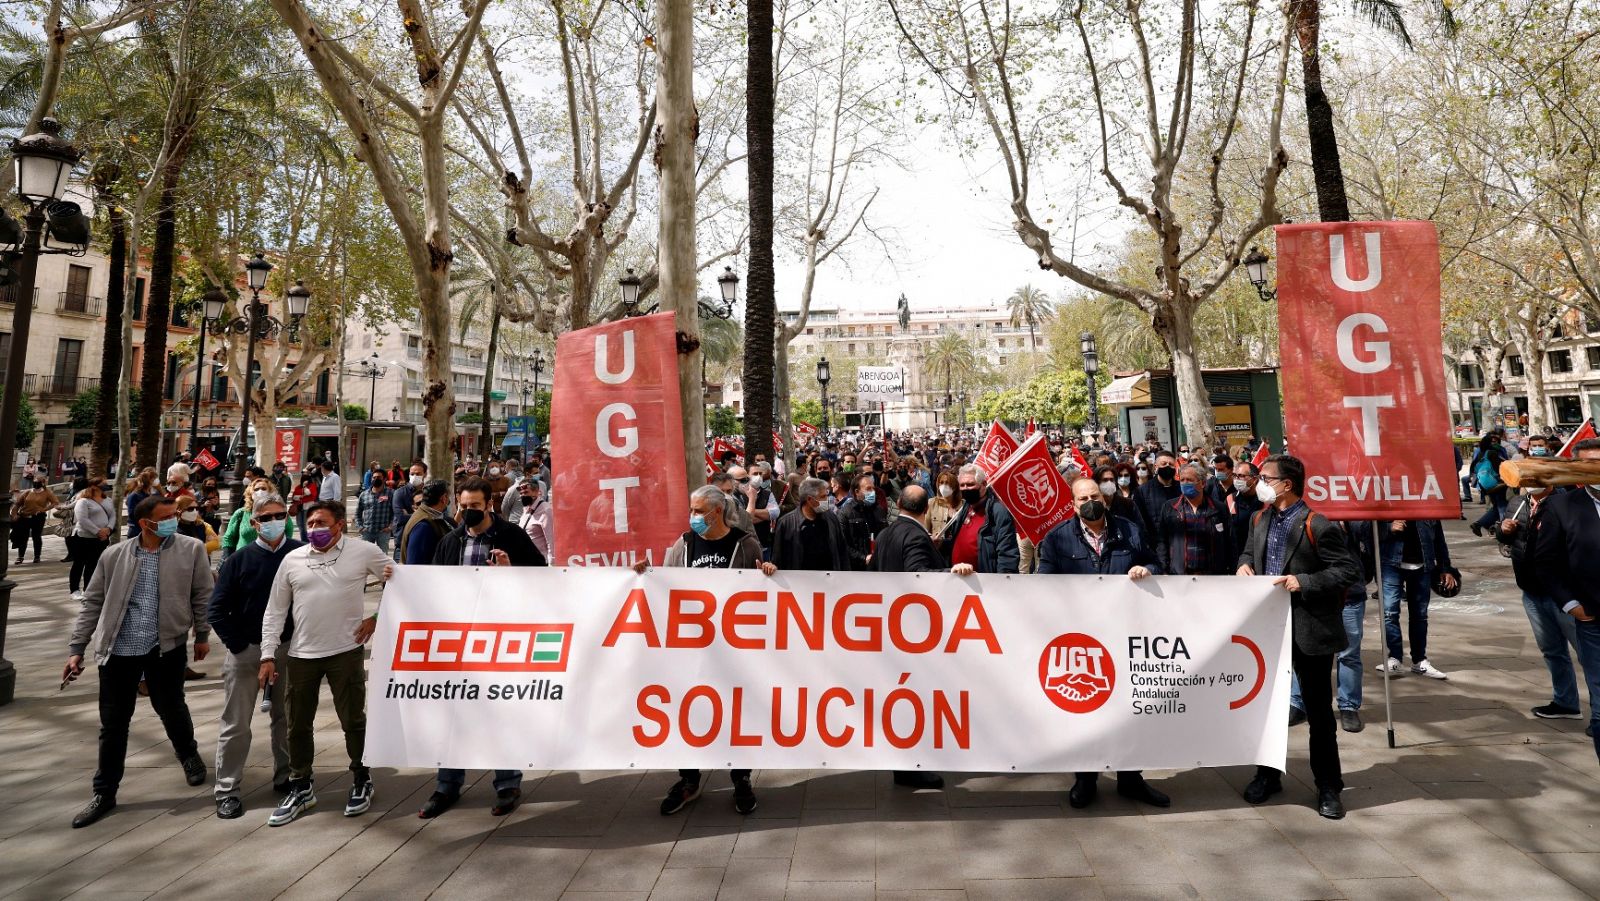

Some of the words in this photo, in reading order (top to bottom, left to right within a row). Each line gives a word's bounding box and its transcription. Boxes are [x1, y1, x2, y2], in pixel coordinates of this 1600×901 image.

[1329, 232, 1393, 457] UGT
[859, 371, 900, 381] ABENGOA
[594, 330, 640, 534] UGT
[1022, 462, 1056, 507] UGT
[1308, 474, 1444, 502] SEVILLA
[602, 588, 1003, 654] ABENGOA
[400, 629, 531, 663] CCOO
[1128, 636, 1191, 660] FICA
[1047, 646, 1104, 677] UGT
[1129, 660, 1185, 674] Industria,
[386, 678, 480, 700] industria
[486, 679, 563, 700] sevilla
[1130, 673, 1206, 687] Construcción
[1209, 676, 1216, 687] y
[1218, 672, 1244, 686] Agro
[632, 671, 970, 750] SOLUCIÓN
[1132, 700, 1186, 715] Sevilla
